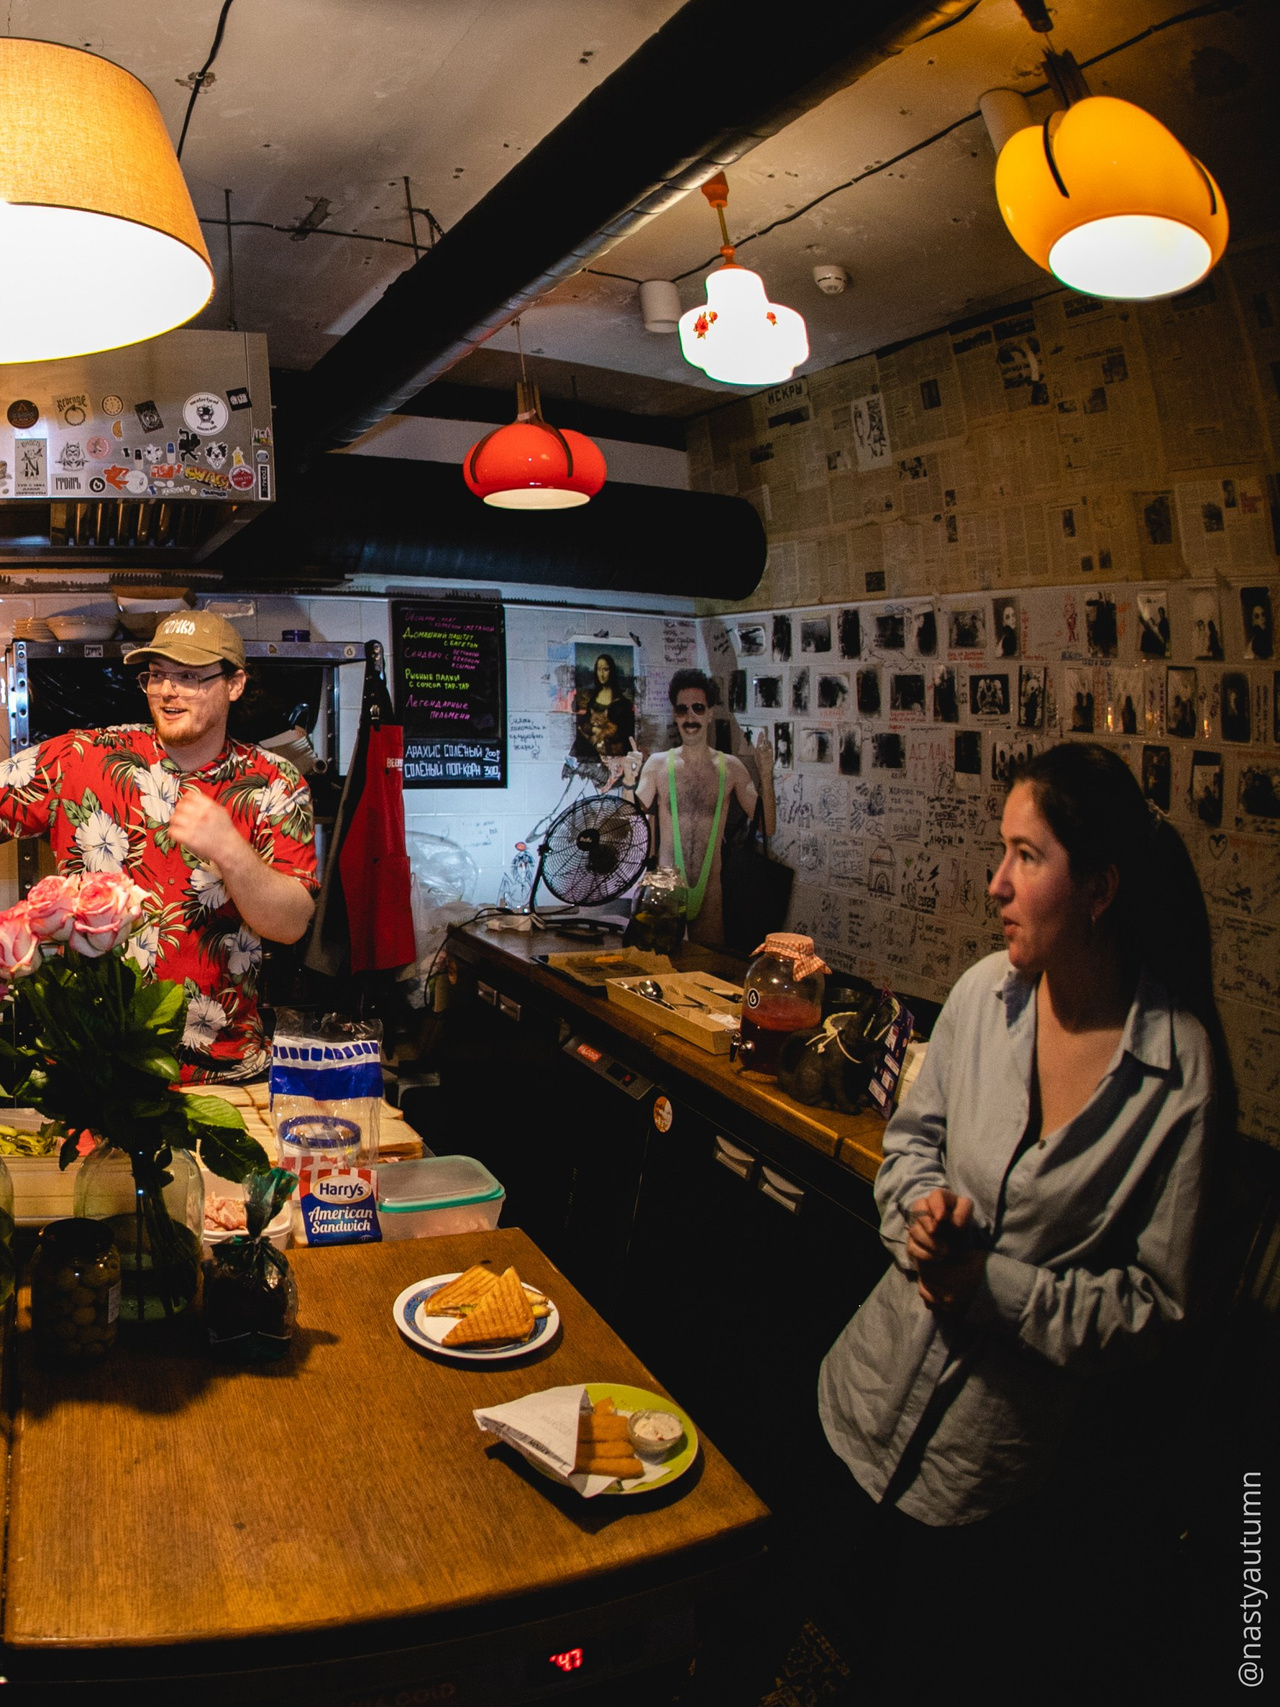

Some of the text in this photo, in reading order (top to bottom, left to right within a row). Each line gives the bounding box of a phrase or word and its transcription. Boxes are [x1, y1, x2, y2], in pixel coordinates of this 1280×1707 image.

[767, 382, 803, 404] ИСКРЫ
[56, 394, 88, 413] Revenge
[405, 745, 441, 758] АРАХИС
[443, 744, 482, 758] СОЛЁНЫЙ
[404, 761, 443, 778] СОЛЁНЫЙ
[446, 762, 481, 777] ПОП-КОРН
[319, 1183, 364, 1198] Harry's
[308, 1206, 373, 1222] American
[311, 1219, 371, 1234] Sandwich
